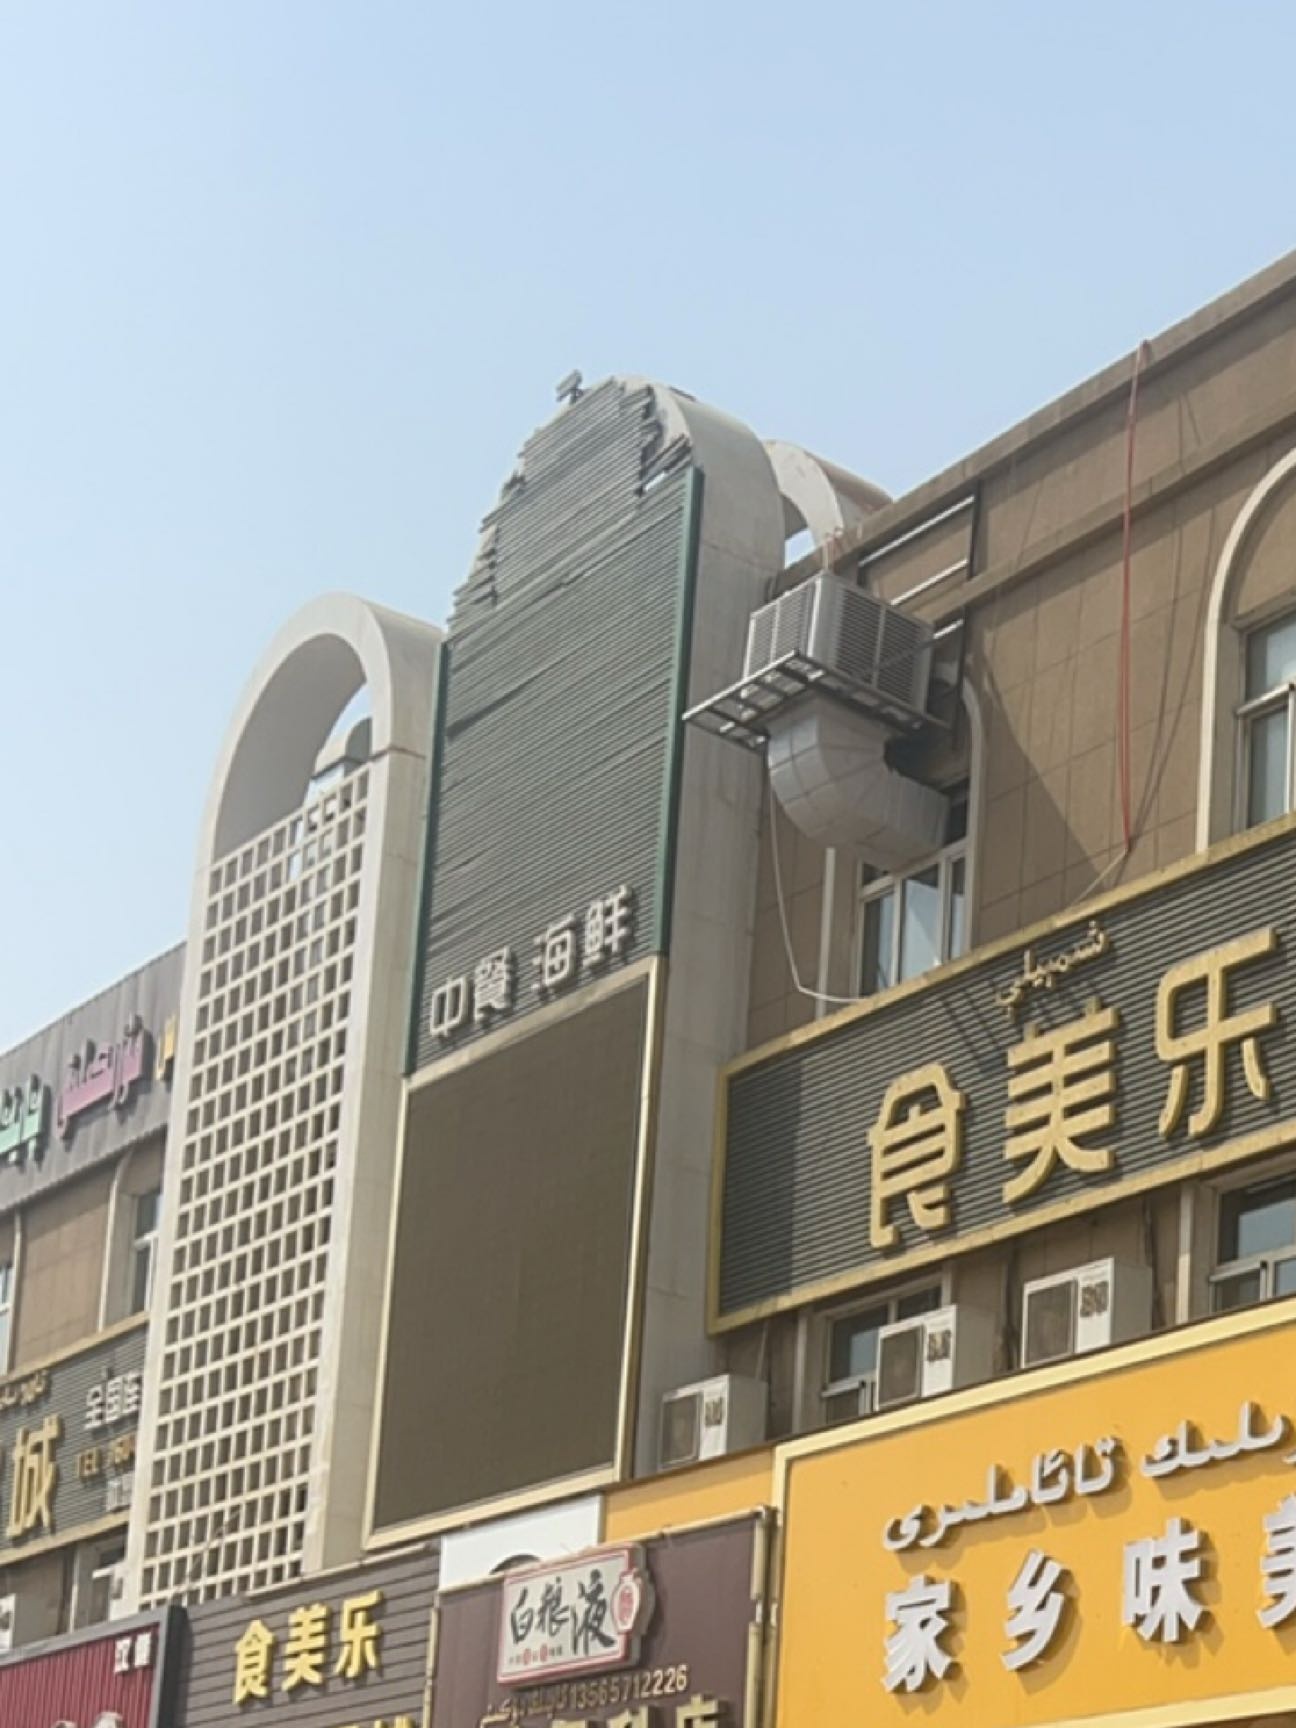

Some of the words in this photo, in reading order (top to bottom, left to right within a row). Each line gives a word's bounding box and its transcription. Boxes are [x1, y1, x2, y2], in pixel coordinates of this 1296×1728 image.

[530, 884, 632, 992] 海鲜
[867, 926, 1281, 1249] 食美乐
[6, 1412, 61, 1538] 城
[233, 1589, 384, 1705] 食美乐
